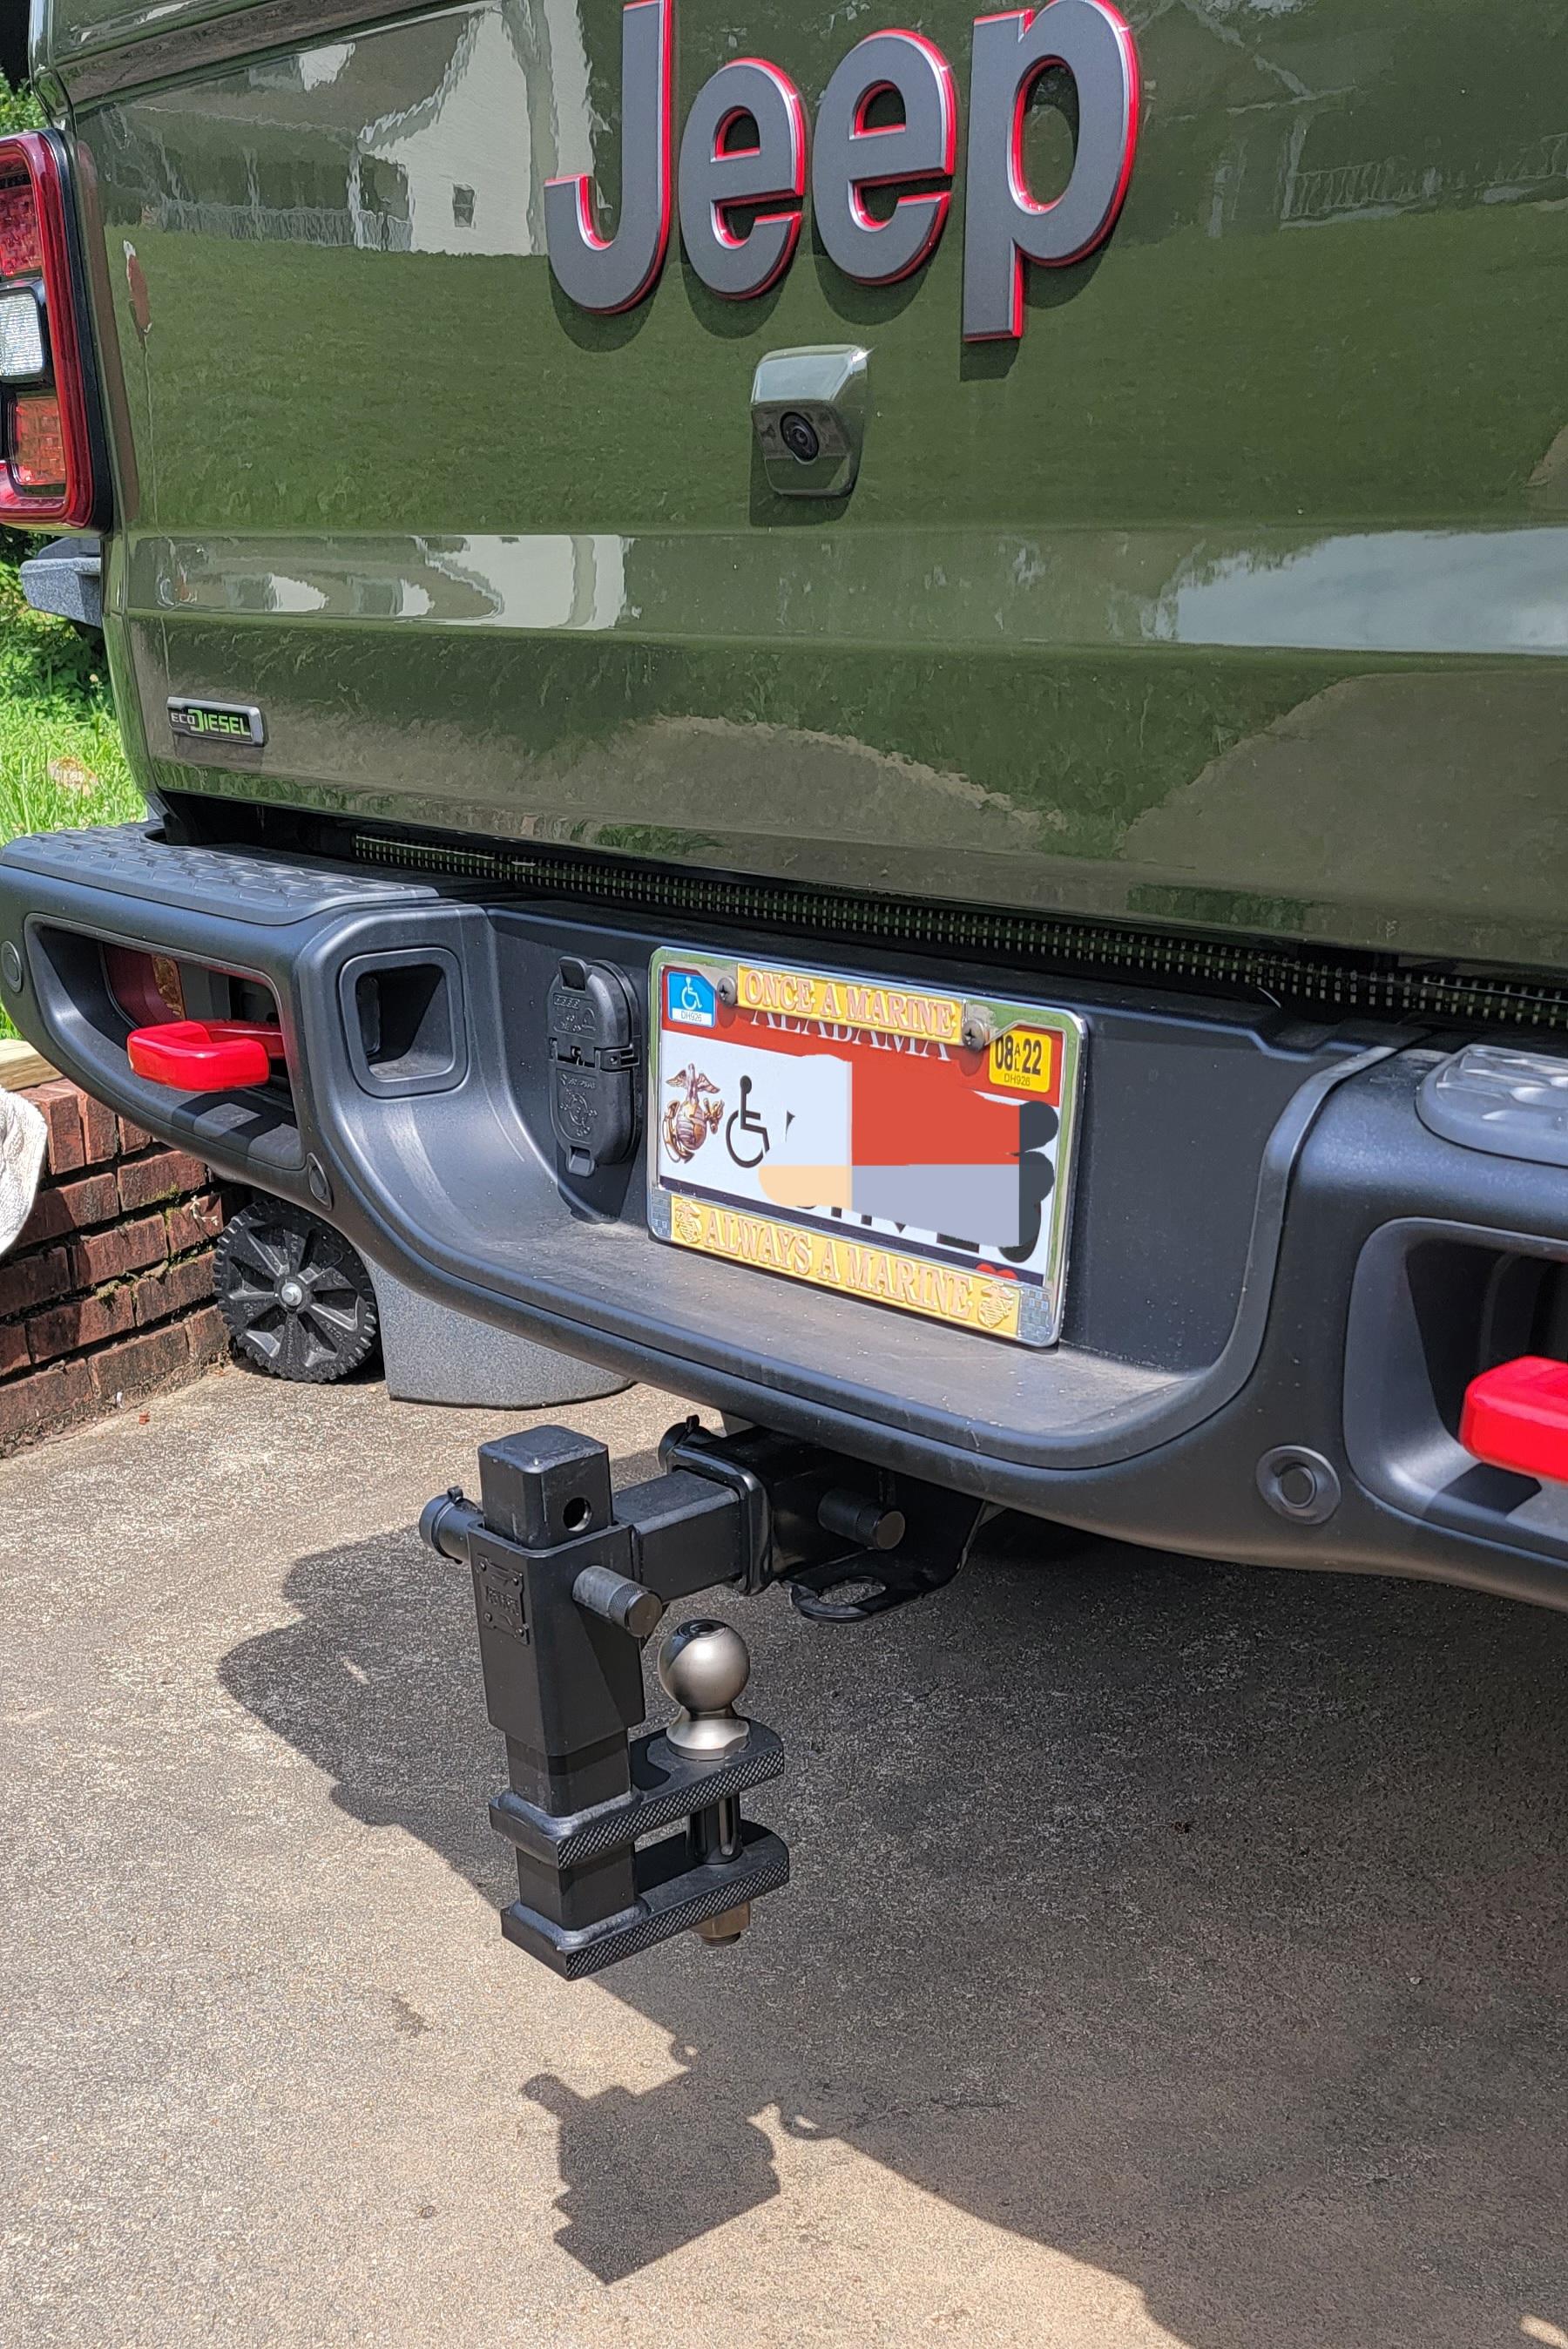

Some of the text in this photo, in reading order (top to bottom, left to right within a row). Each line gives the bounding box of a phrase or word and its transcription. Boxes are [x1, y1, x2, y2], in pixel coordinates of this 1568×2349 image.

[544, 0, 1140, 342] Jeep
[745, 970, 815, 1013] ONCE
[821, 982, 842, 1018] A
[846, 985, 956, 1038] MARINE
[996, 1035, 1013, 1071] 08
[1023, 1039, 1041, 1075] 22
[703, 1208, 974, 1319] ALWAYS A MARINE
